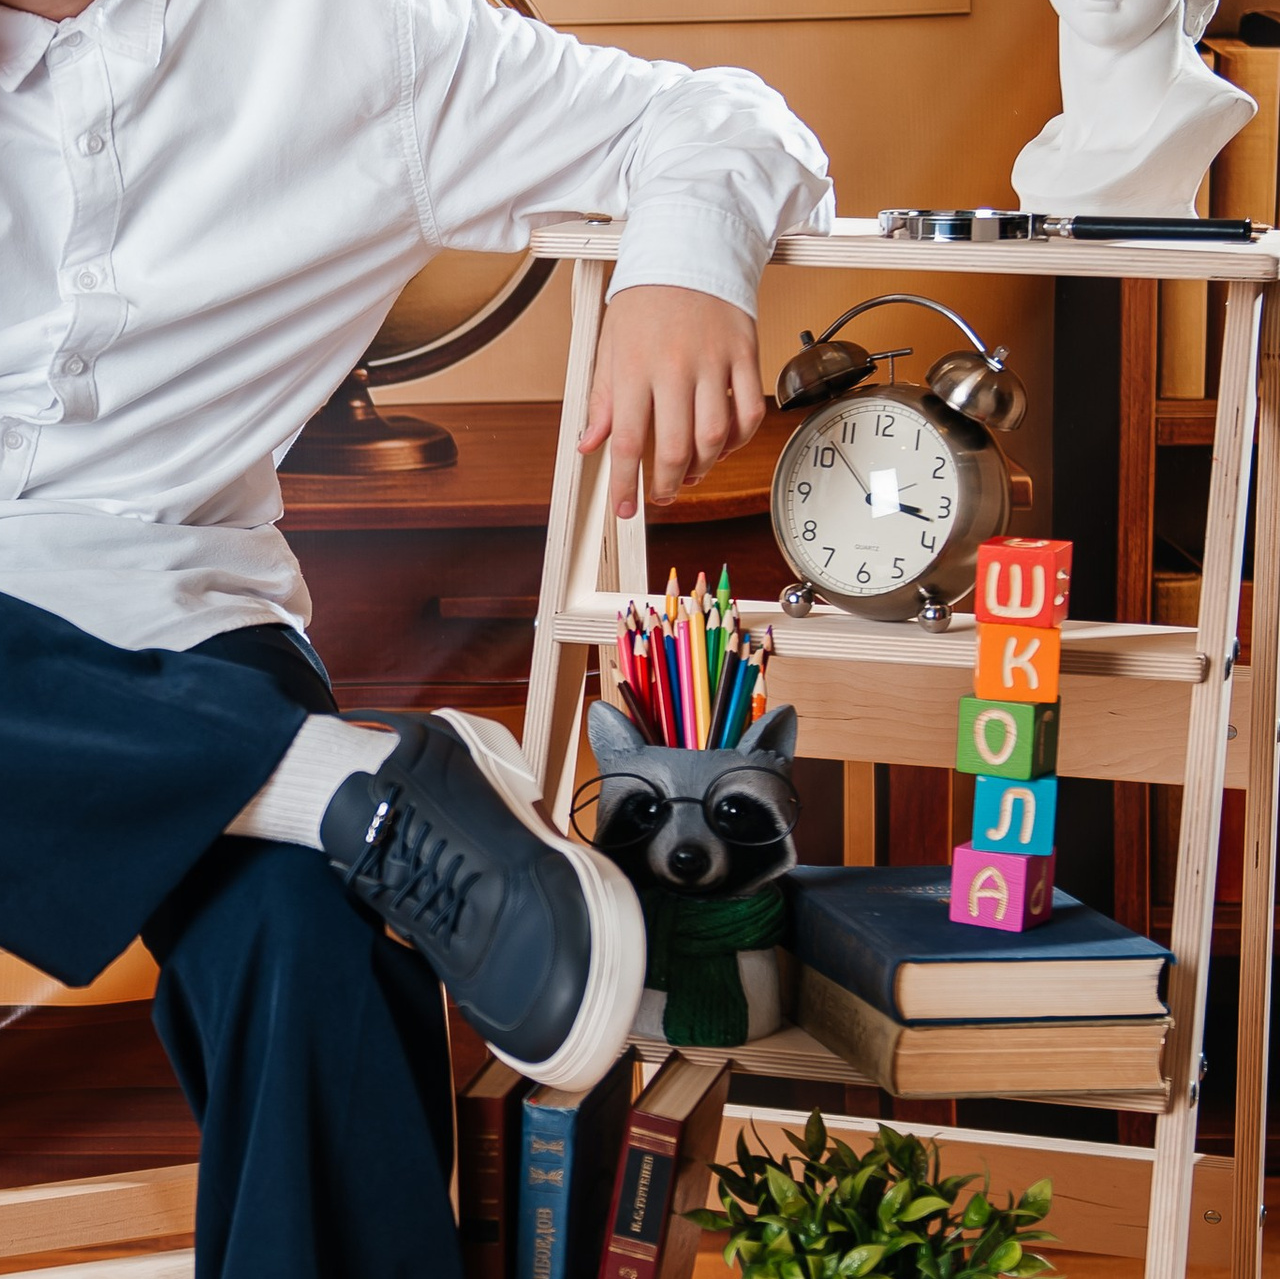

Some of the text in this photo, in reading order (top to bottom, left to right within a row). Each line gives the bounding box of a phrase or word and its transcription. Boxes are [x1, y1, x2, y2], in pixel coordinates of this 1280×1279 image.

[842, 422, 856, 444] 11
[875, 414, 895, 438] 12
[915, 429, 922, 451] 1
[813, 445, 835, 468] 10
[932, 456, 946, 480] 2
[797, 481, 812, 504] 9
[938, 496, 952, 519] 3
[802, 520, 817, 542] 8
[920, 530, 936, 554] 4
[822, 547, 836, 568] 7
[891, 557, 906, 579] 5
[856, 562, 871, 584] 6
